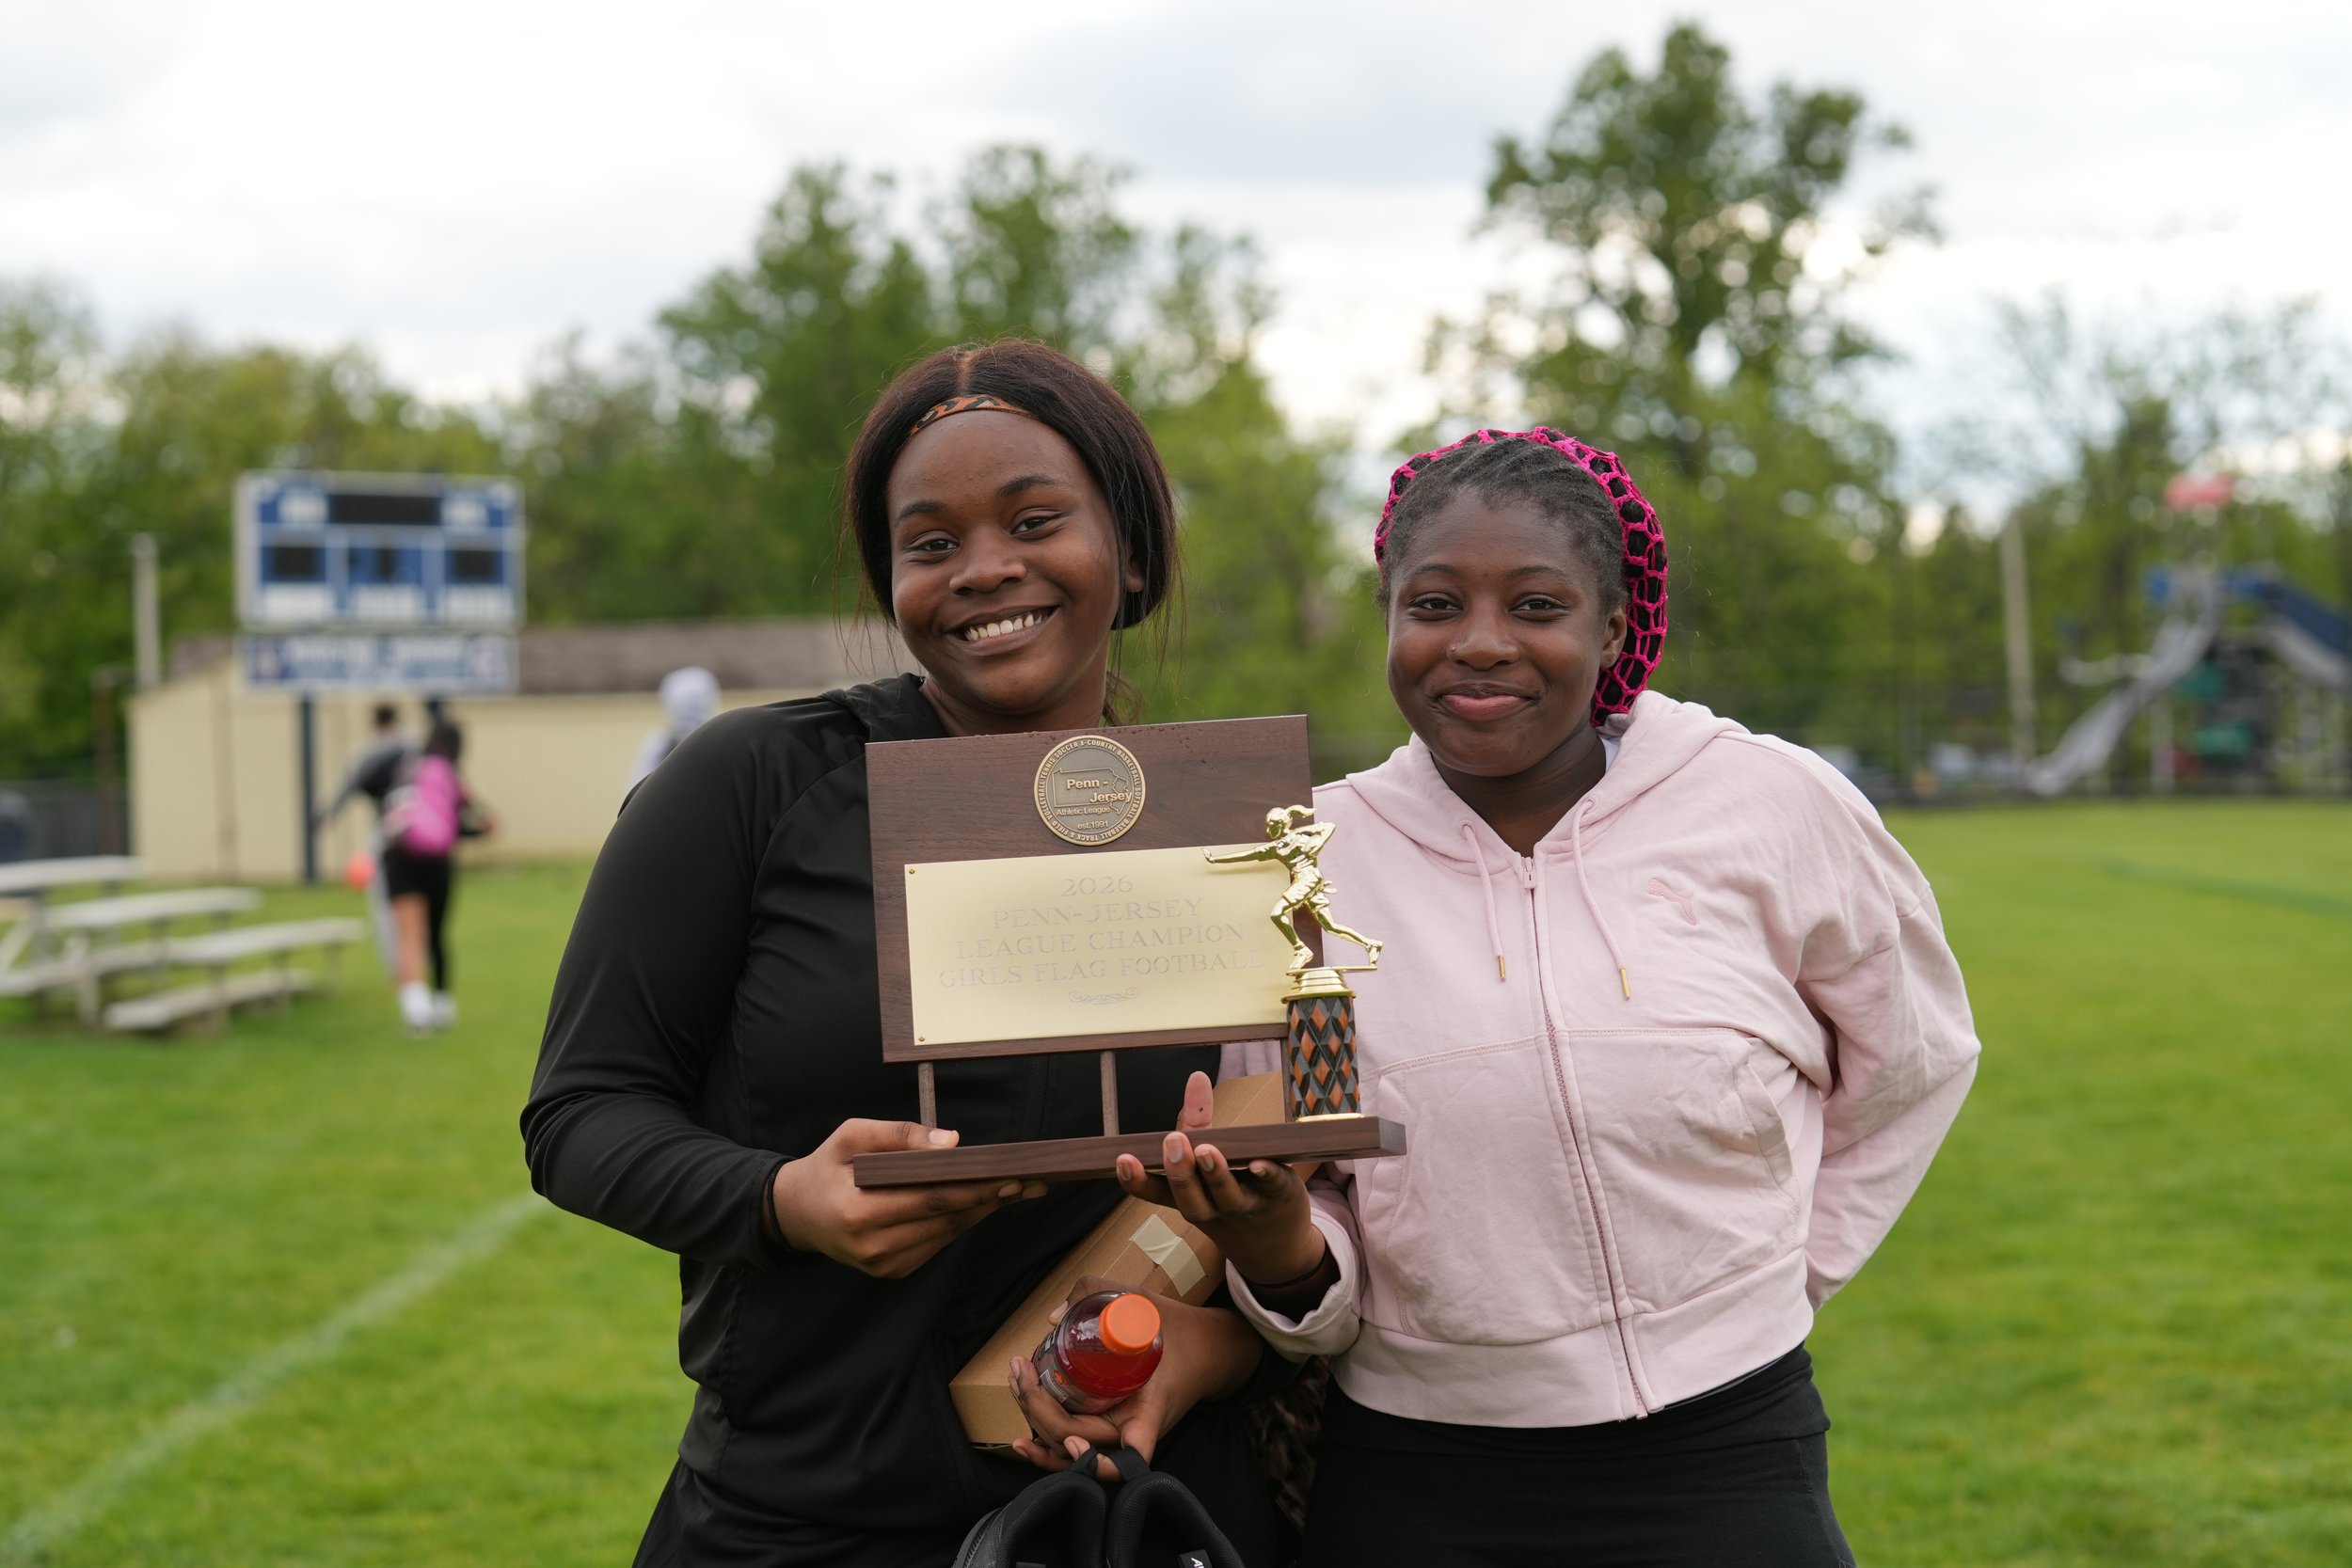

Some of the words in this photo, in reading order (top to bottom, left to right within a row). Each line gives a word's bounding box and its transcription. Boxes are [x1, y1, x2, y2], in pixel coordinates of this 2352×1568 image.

[1055, 741, 1078, 758] SOCCER
[1080, 739, 1117, 752] X-COUNTRY
[1041, 758, 1056, 780] TENNIS
[1117, 749, 1142, 785] BASKETBALL
[1066, 779, 1100, 790] Penn
[1038, 782, 1054, 820] VOLLEYBALL
[1089, 792, 1132, 803] Jersey
[1126, 787, 1141, 817] SOFTBALL
[1057, 807, 1083, 816] Athletic
[1052, 821, 1068, 835] FIELD
[1100, 818, 1130, 841] BASEBALL
[1061, 875, 1134, 898] 2026
[993, 897, 1204, 929] PENN-JERSEY
[956, 932, 1077, 960] LEAGUE
[1089, 923, 1245, 951] CHAMPION
[939, 961, 1023, 990] GIRLS
[1035, 958, 1106, 983] FLAG
[1120, 949, 1265, 976] FOOTBALL
